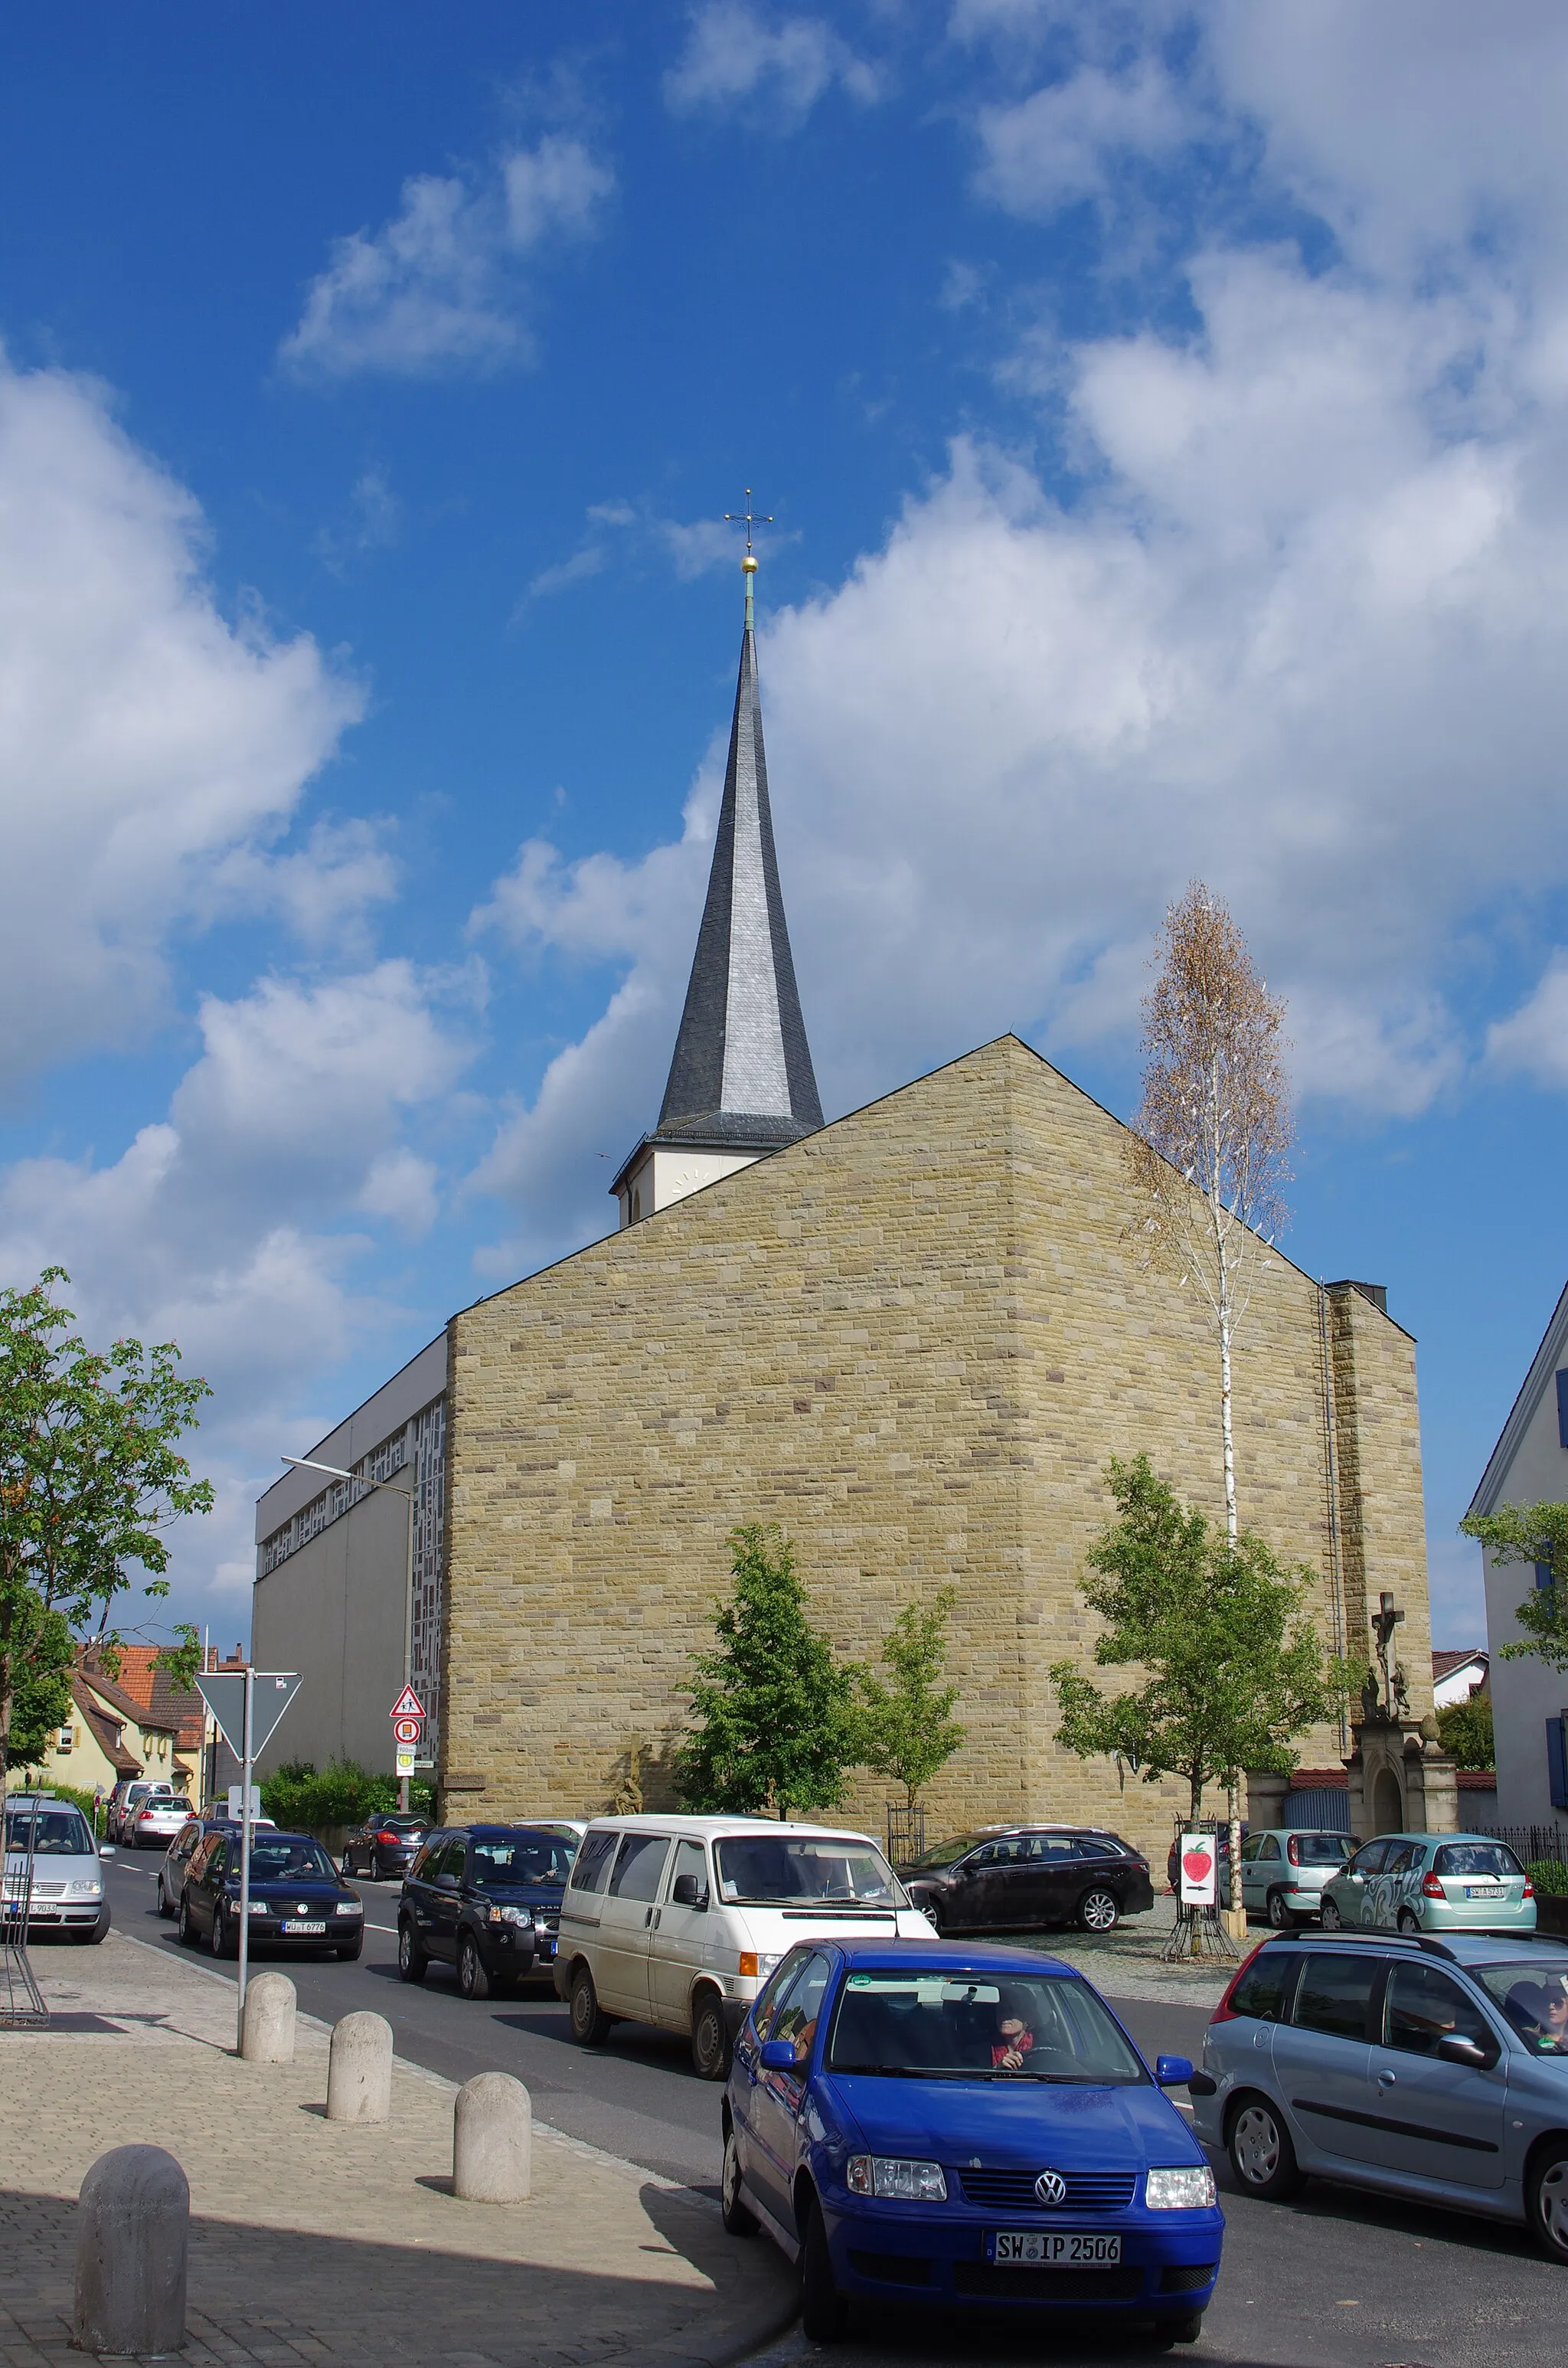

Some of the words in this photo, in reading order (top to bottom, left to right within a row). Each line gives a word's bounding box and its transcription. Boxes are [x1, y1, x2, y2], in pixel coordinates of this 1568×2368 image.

[998, 2235, 1024, 2258] SW
[1040, 2236, 1065, 2259] IP
[1070, 2236, 1119, 2260] 2506
